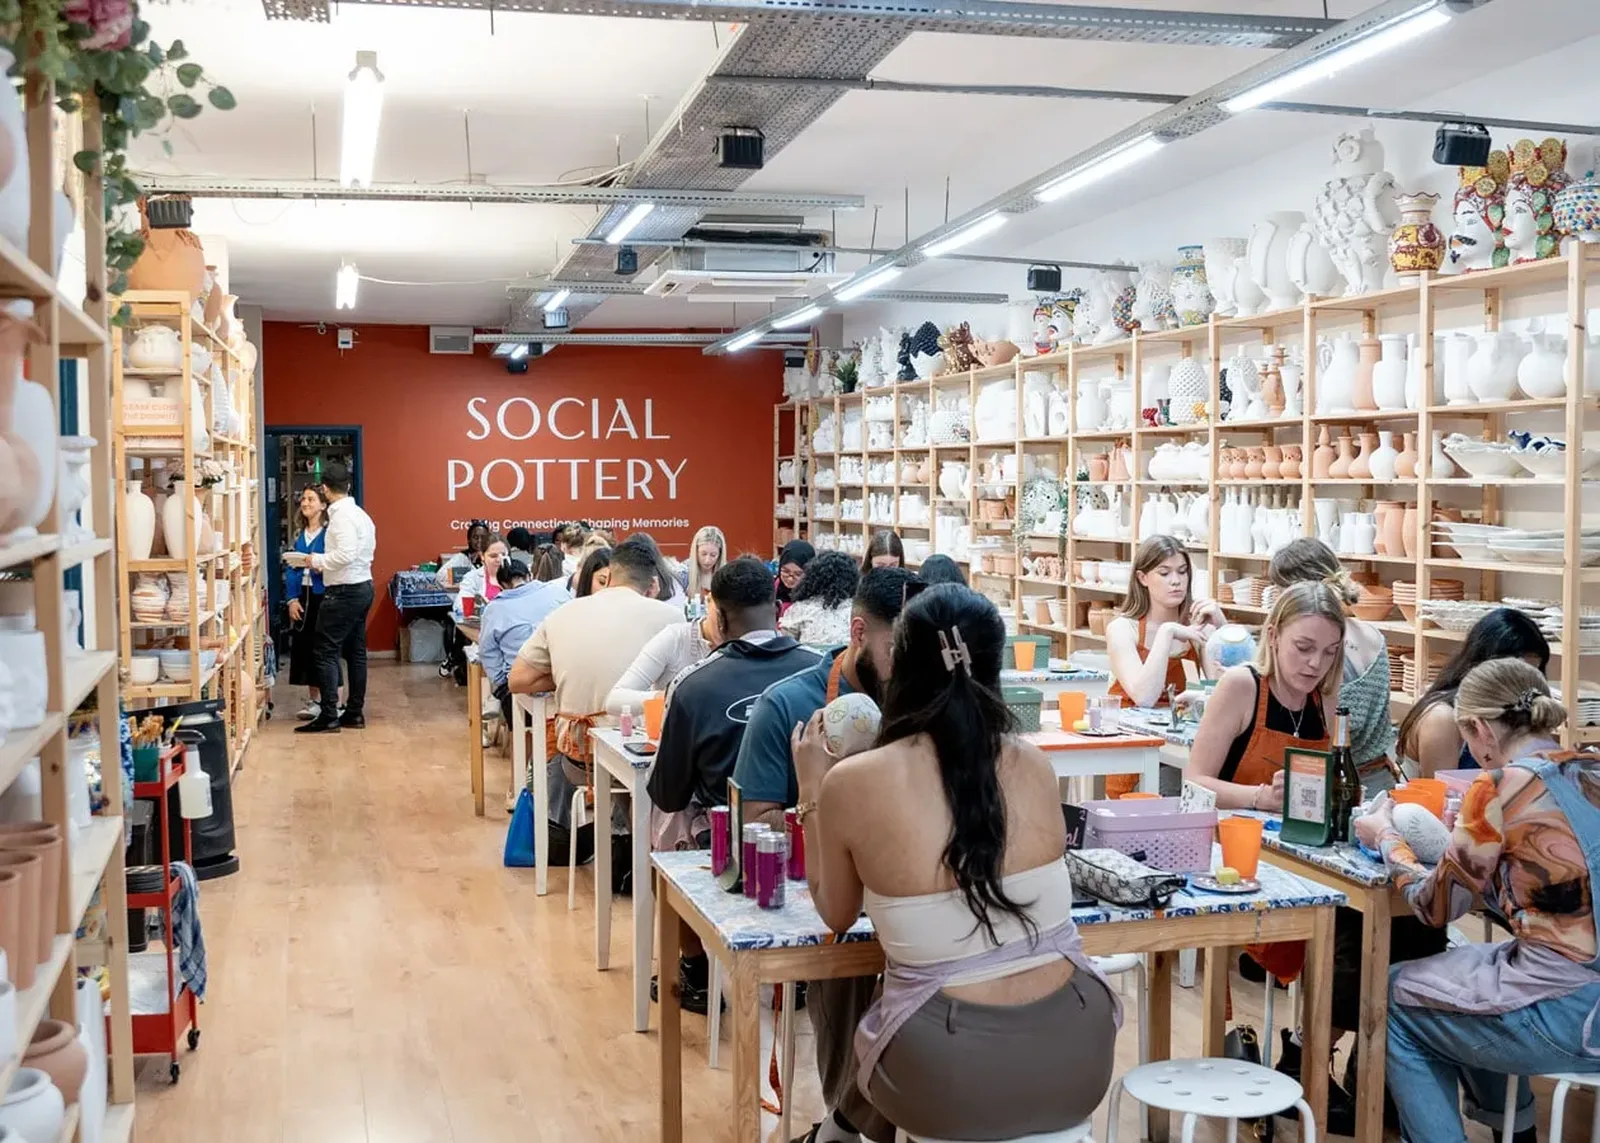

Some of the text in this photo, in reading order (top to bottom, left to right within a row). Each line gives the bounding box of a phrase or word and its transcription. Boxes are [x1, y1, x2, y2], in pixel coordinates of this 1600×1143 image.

[466, 397, 671, 440] SOCIAL
[447, 458, 688, 502] POTTERY
[633, 516, 689, 529] Memories
